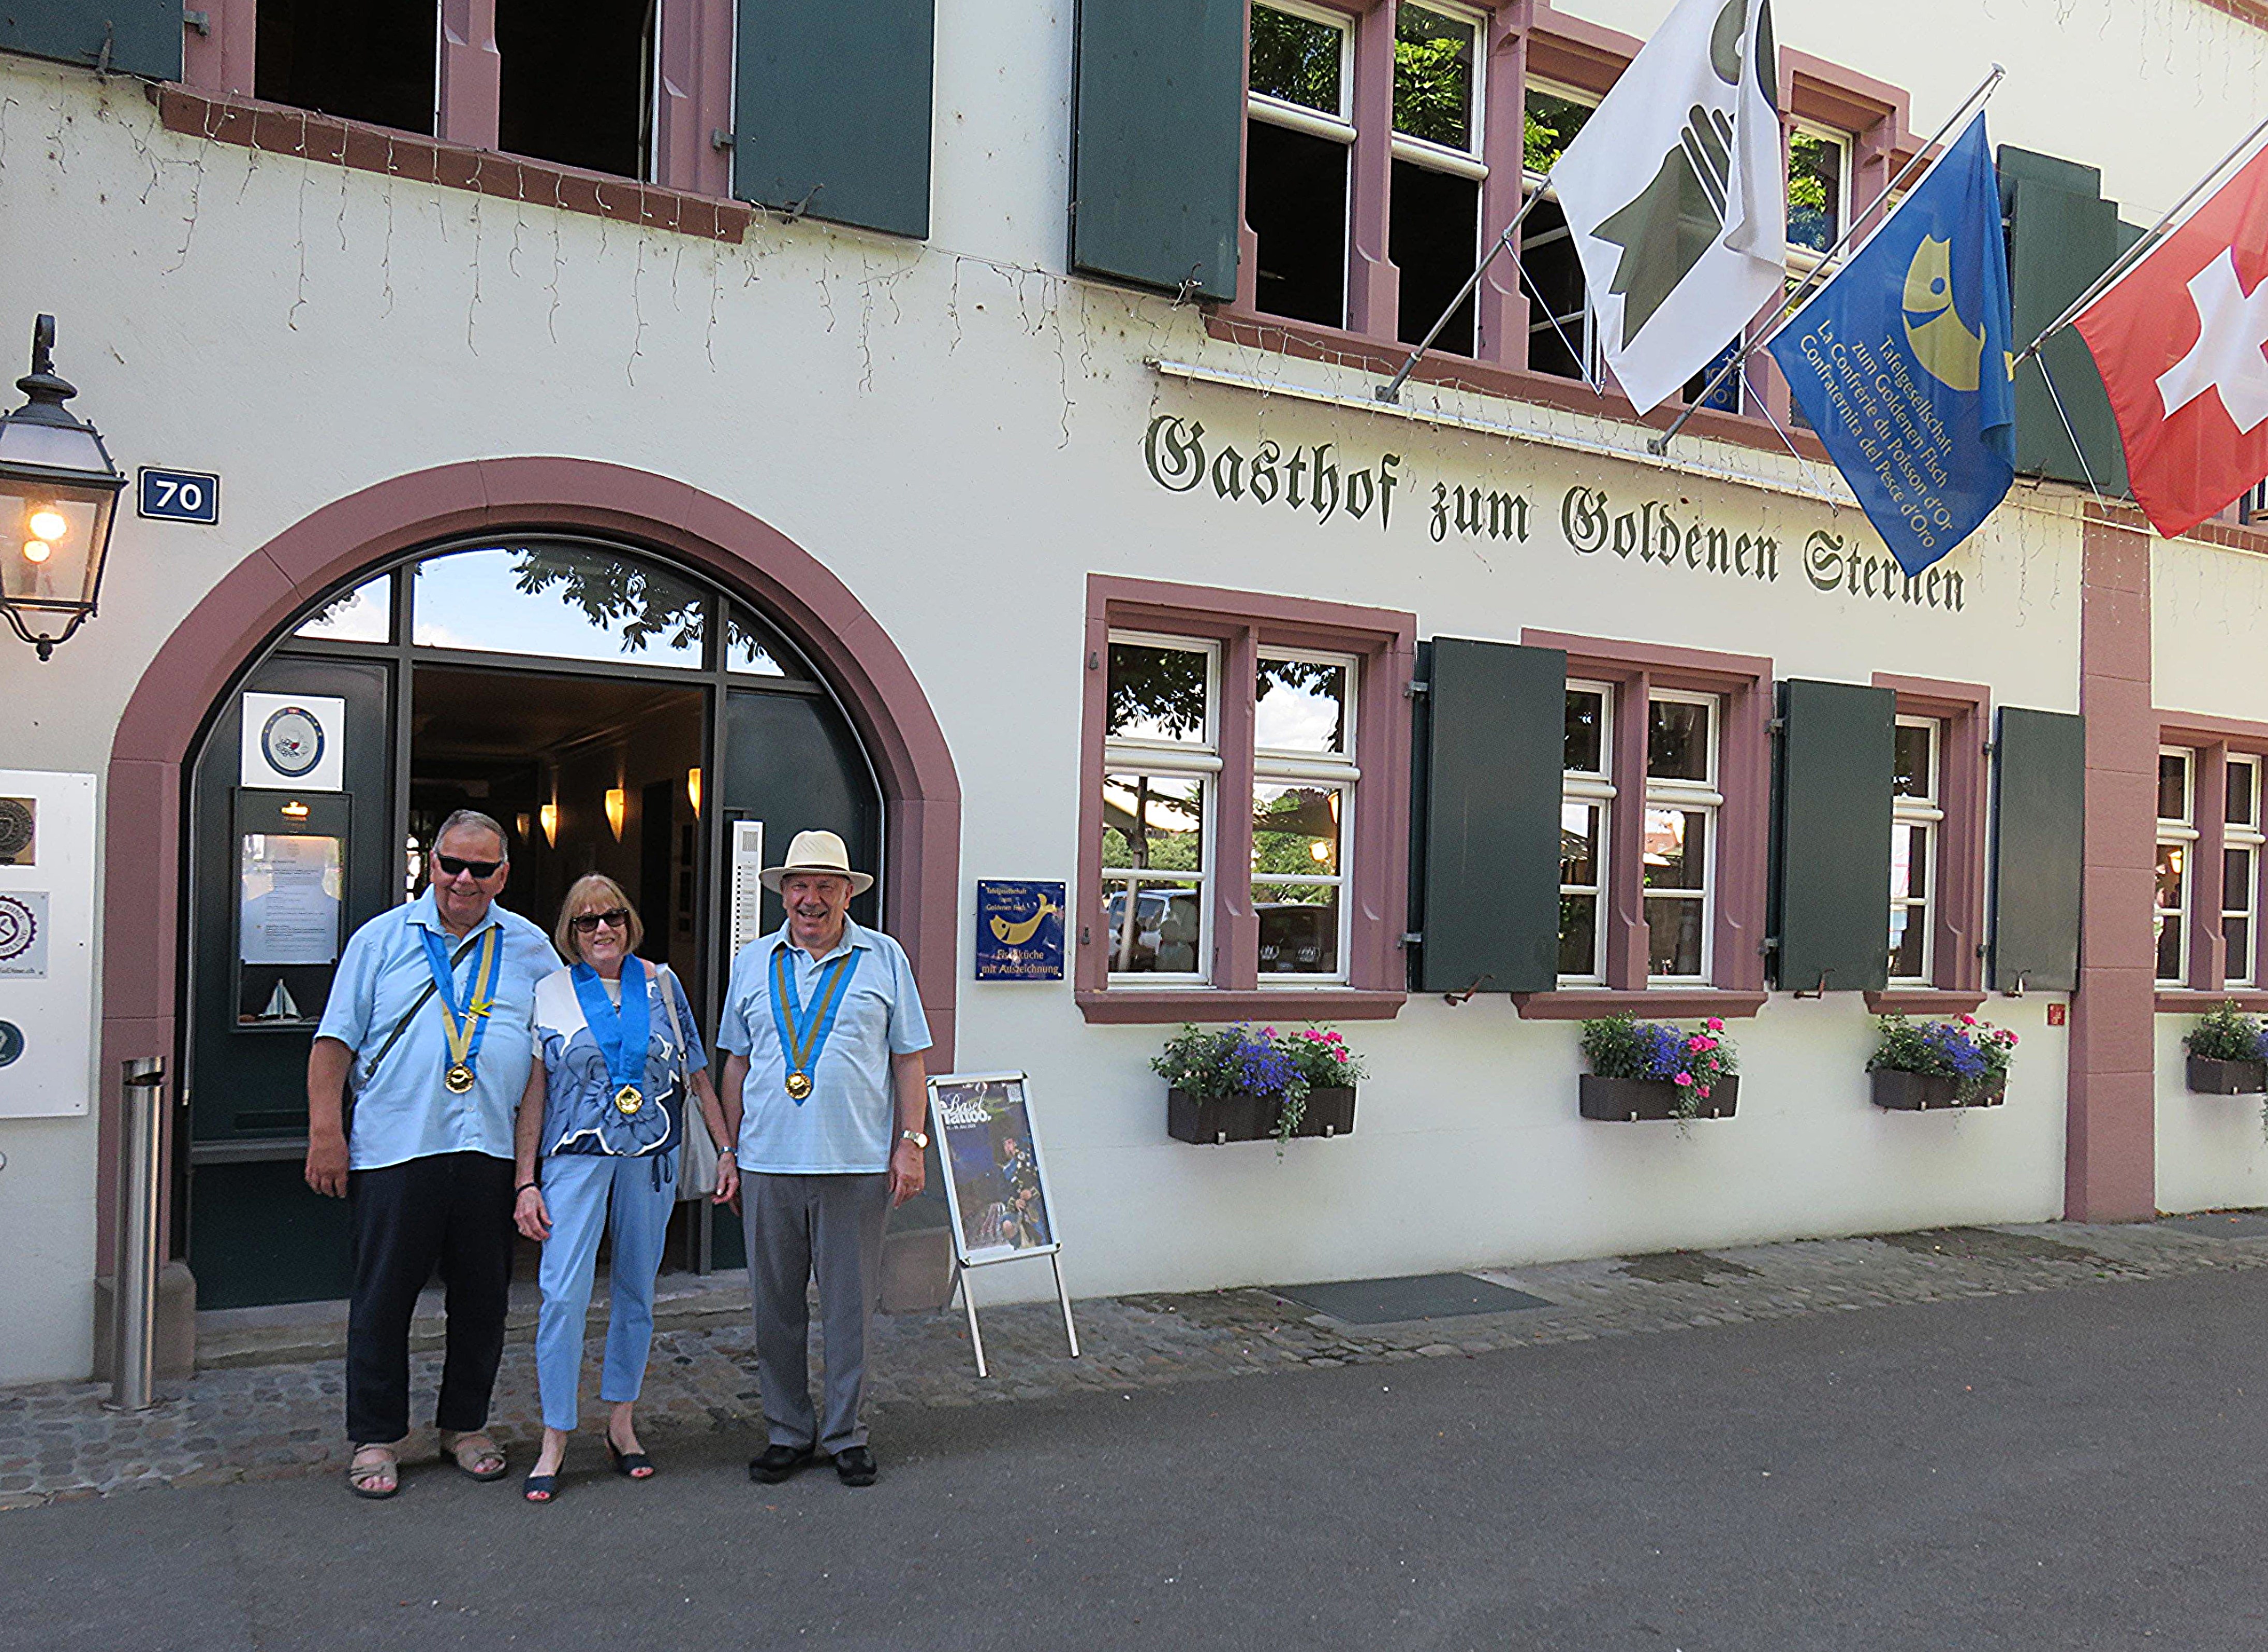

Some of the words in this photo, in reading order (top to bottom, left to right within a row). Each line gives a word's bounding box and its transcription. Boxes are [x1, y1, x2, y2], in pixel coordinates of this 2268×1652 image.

[1800, 334, 1863, 437] Confraternita
[1859, 437, 1883, 463] del
[1875, 460, 1905, 502] Pesce
[1900, 504, 1935, 547] d'Oro
[1817, 319, 1833, 344] La
[1831, 343, 1878, 417] Confrérie
[1874, 418, 1892, 440] du
[1887, 437, 1927, 496] Poisson
[1924, 496, 1953, 531] d'Or
[1852, 341, 1878, 375] zum
[1876, 374, 1924, 449] Goldenen
[1920, 447, 1948, 488] Fisch
[1879, 334, 1953, 457] Tafelgesellschaft
[156, 480, 202, 510] 70
[1144, 415, 1400, 533] Gasthof
[1429, 481, 1530, 544] zum
[1560, 485, 1780, 583] Goldenen
[1804, 529, 1965, 613] Sternen
[997, 948, 1044, 960] Fisküche
